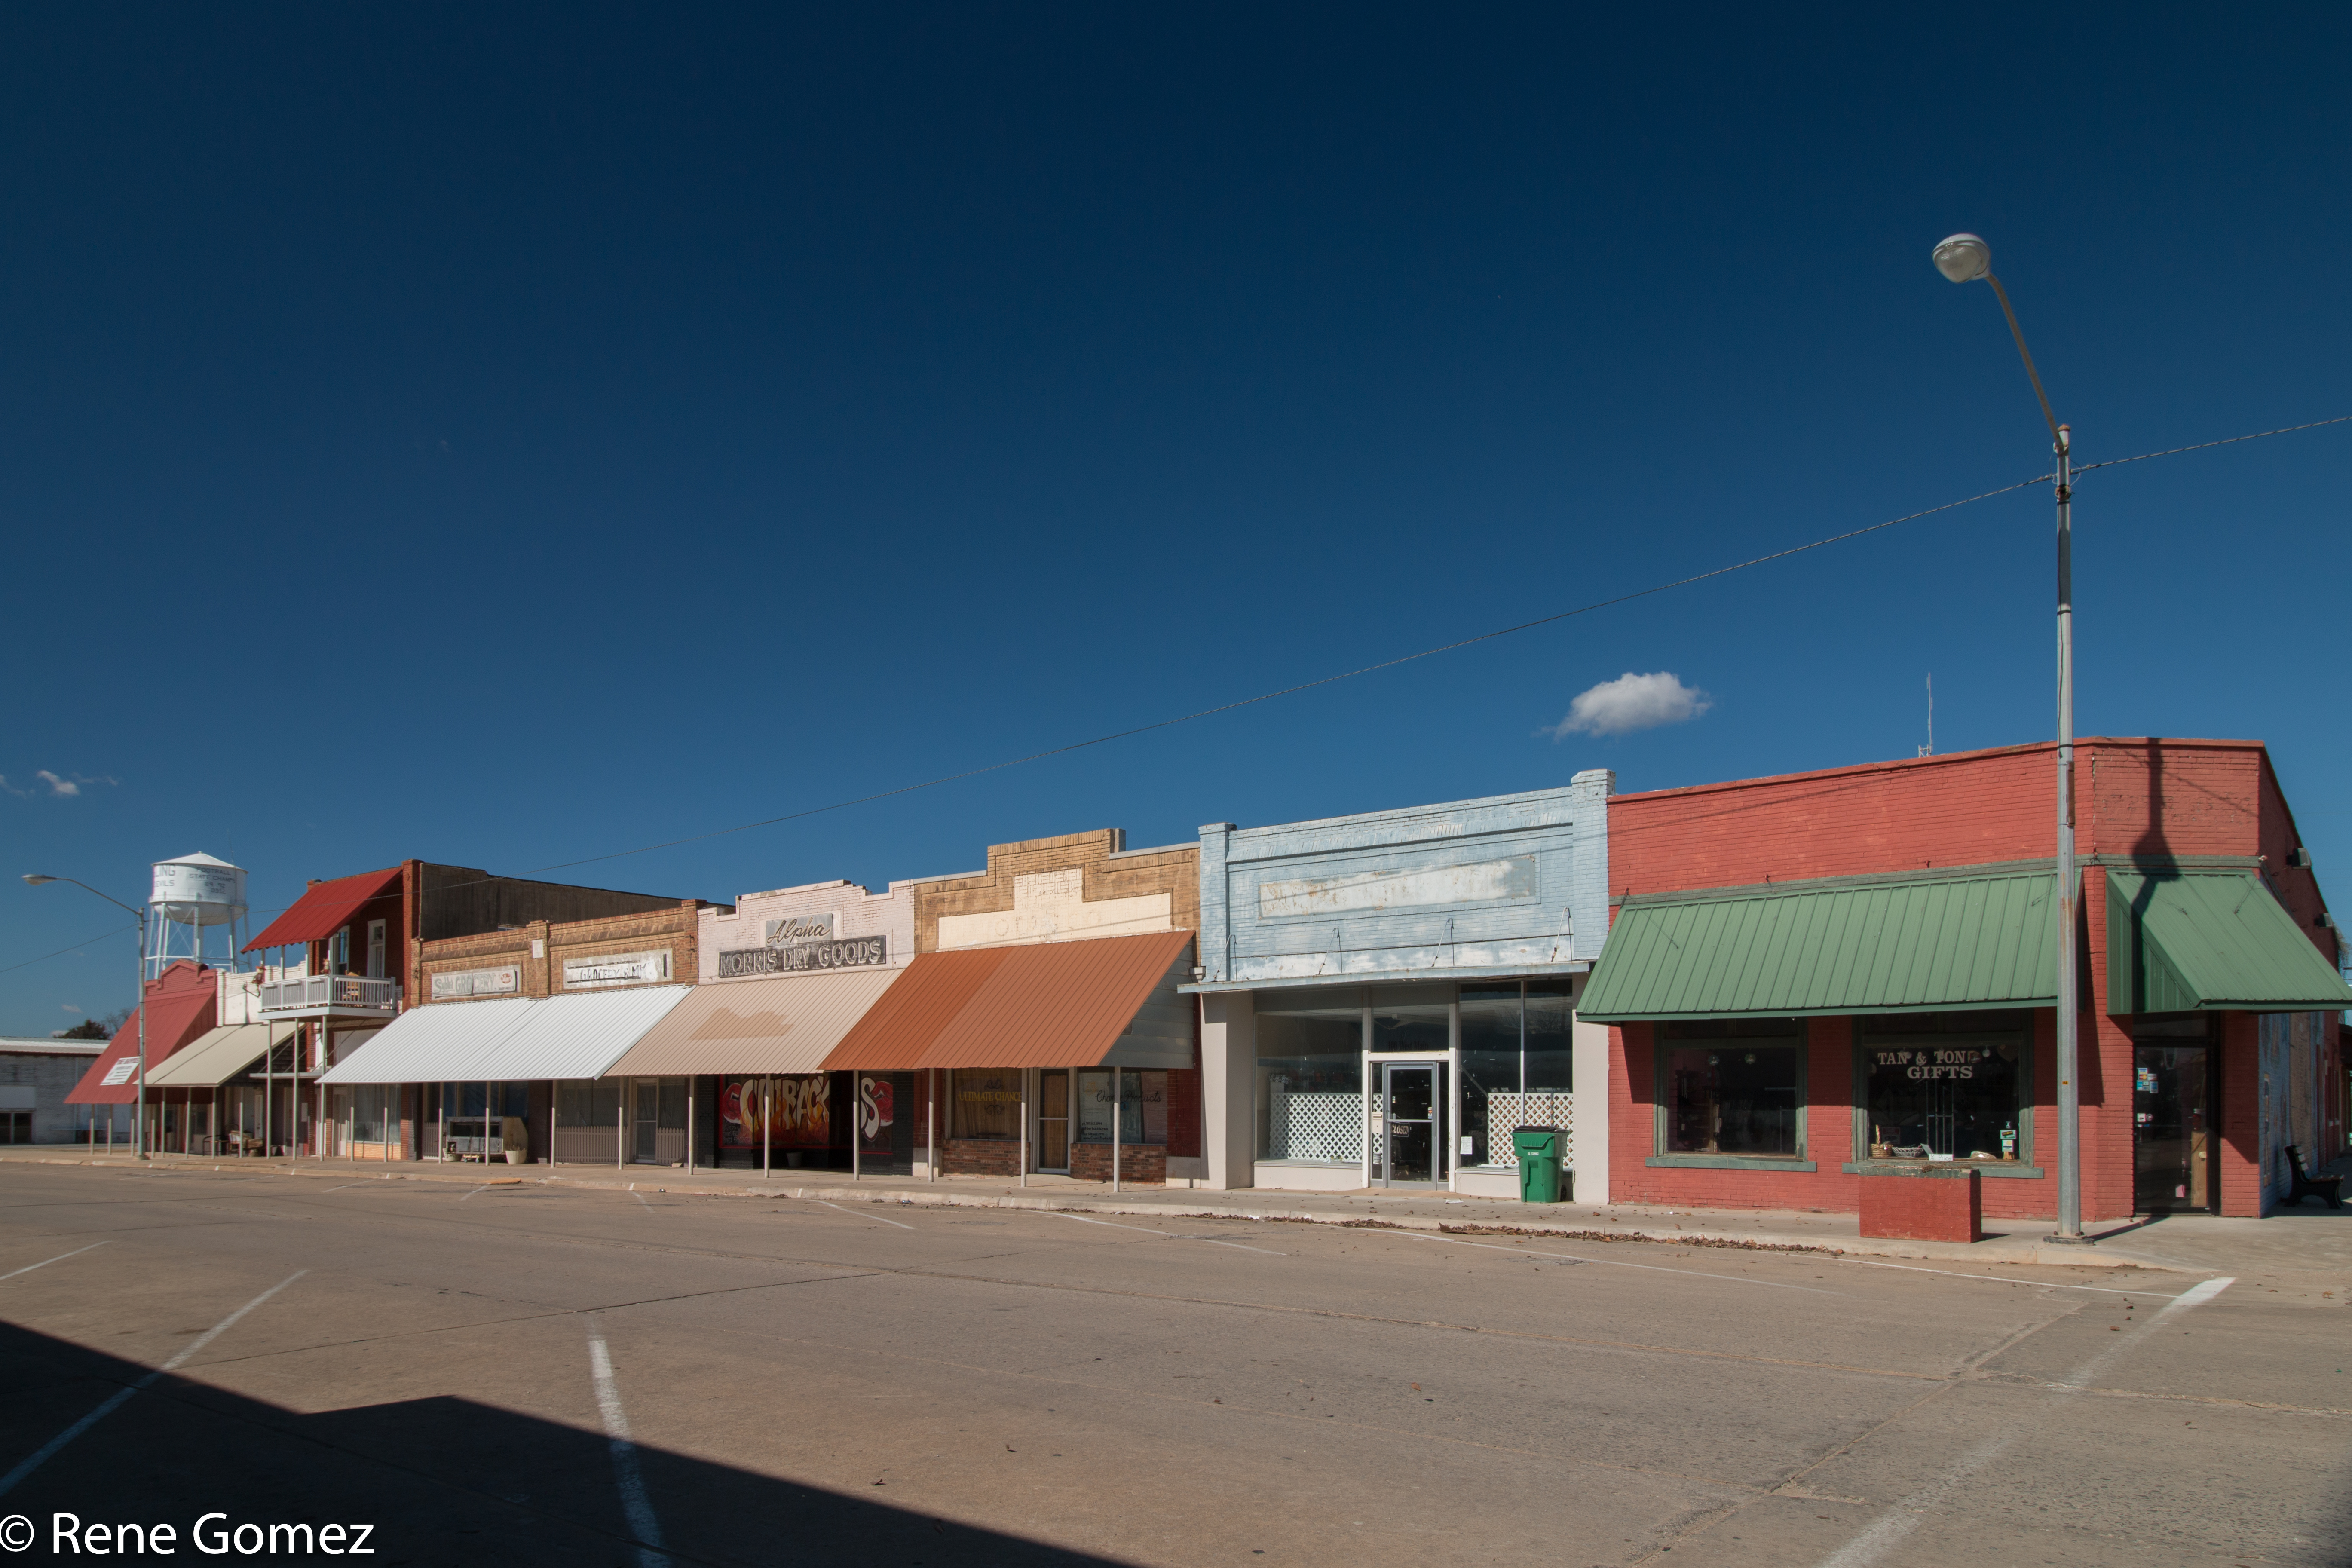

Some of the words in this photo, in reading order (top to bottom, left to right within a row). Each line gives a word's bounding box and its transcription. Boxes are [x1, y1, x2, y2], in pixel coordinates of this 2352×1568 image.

[197, 867, 231, 876] FOOTBALL
[767, 916, 831, 944] Alpha
[720, 950, 777, 976] MORRIS
[783, 947, 811, 971] DRY
[818, 940, 882, 966] GOODS
[456, 973, 495, 993] GROCERY
[1877, 1052, 1907, 1065] TAN
[1916, 1052, 1926, 1065] &
[1934, 1051, 1978, 1064] TON
[1907, 1066, 1972, 1079] GIFTS
[959, 1091, 994, 1101] ULTIMATE
[995, 1091, 1022, 1101] CHANCE
[1124, 1090, 1161, 1102] Products
[1392, 1124, 1409, 1135] CLOSED
